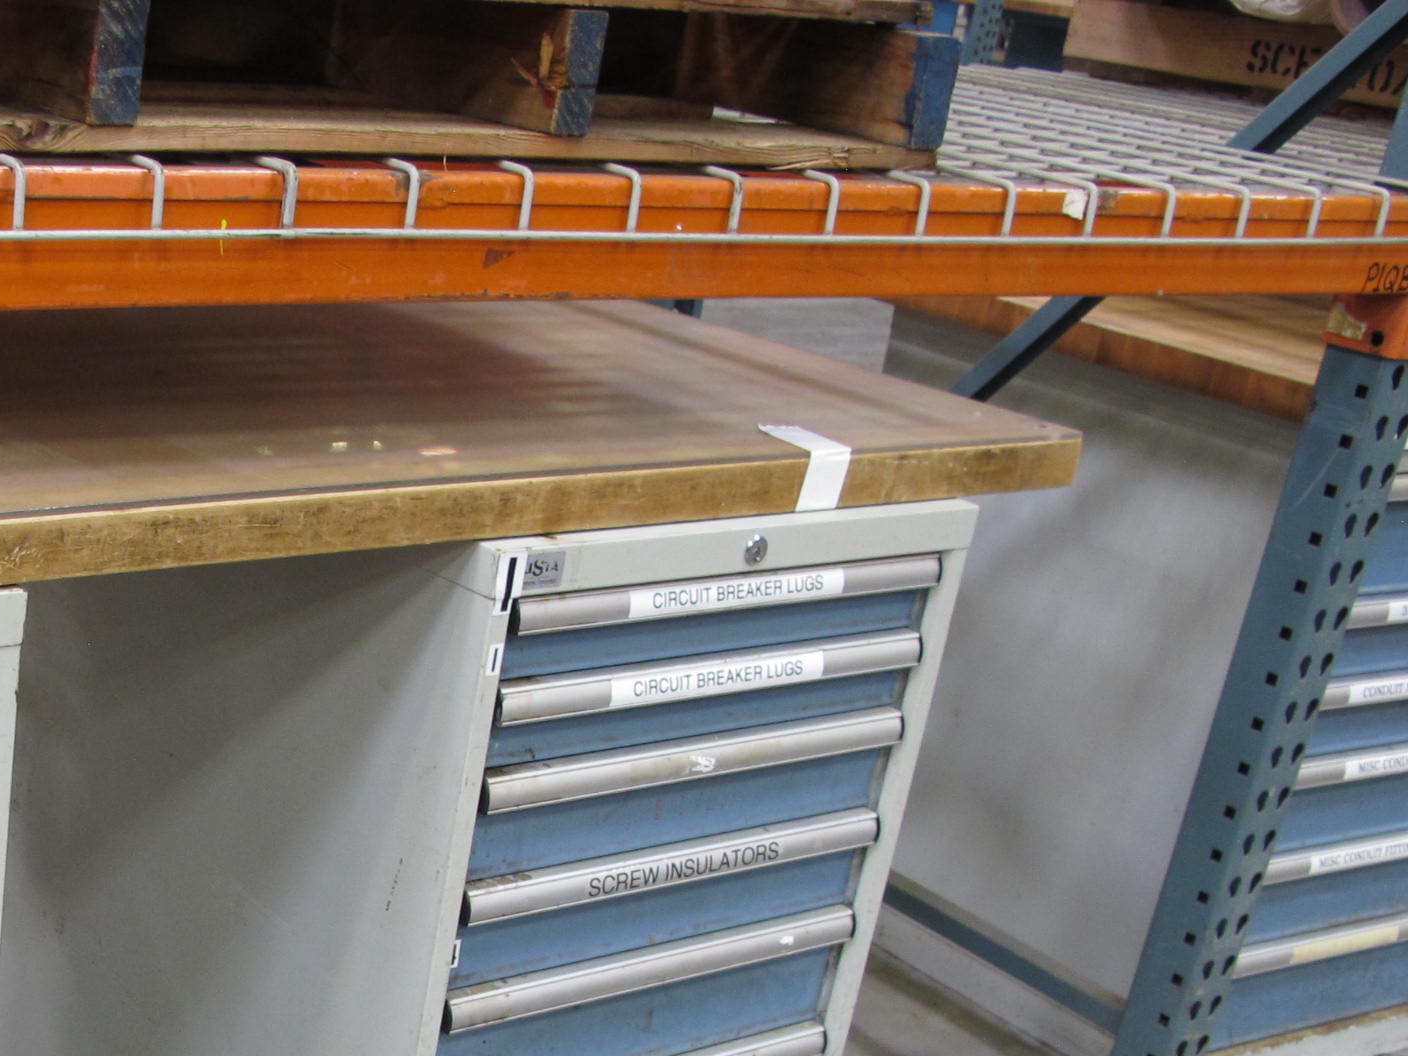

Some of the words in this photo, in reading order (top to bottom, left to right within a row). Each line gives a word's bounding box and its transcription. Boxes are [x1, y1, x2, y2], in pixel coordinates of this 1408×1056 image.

[652, 587, 711, 608] CIRCUIT
[716, 581, 784, 601] BREAKER
[786, 574, 824, 594] LUGS
[633, 677, 691, 697] CIRCUIT
[696, 669, 762, 690] BREAKER
[766, 661, 804, 682] LUGS
[588, 865, 660, 897] SCREW
[665, 842, 779, 879] INSULATORS
